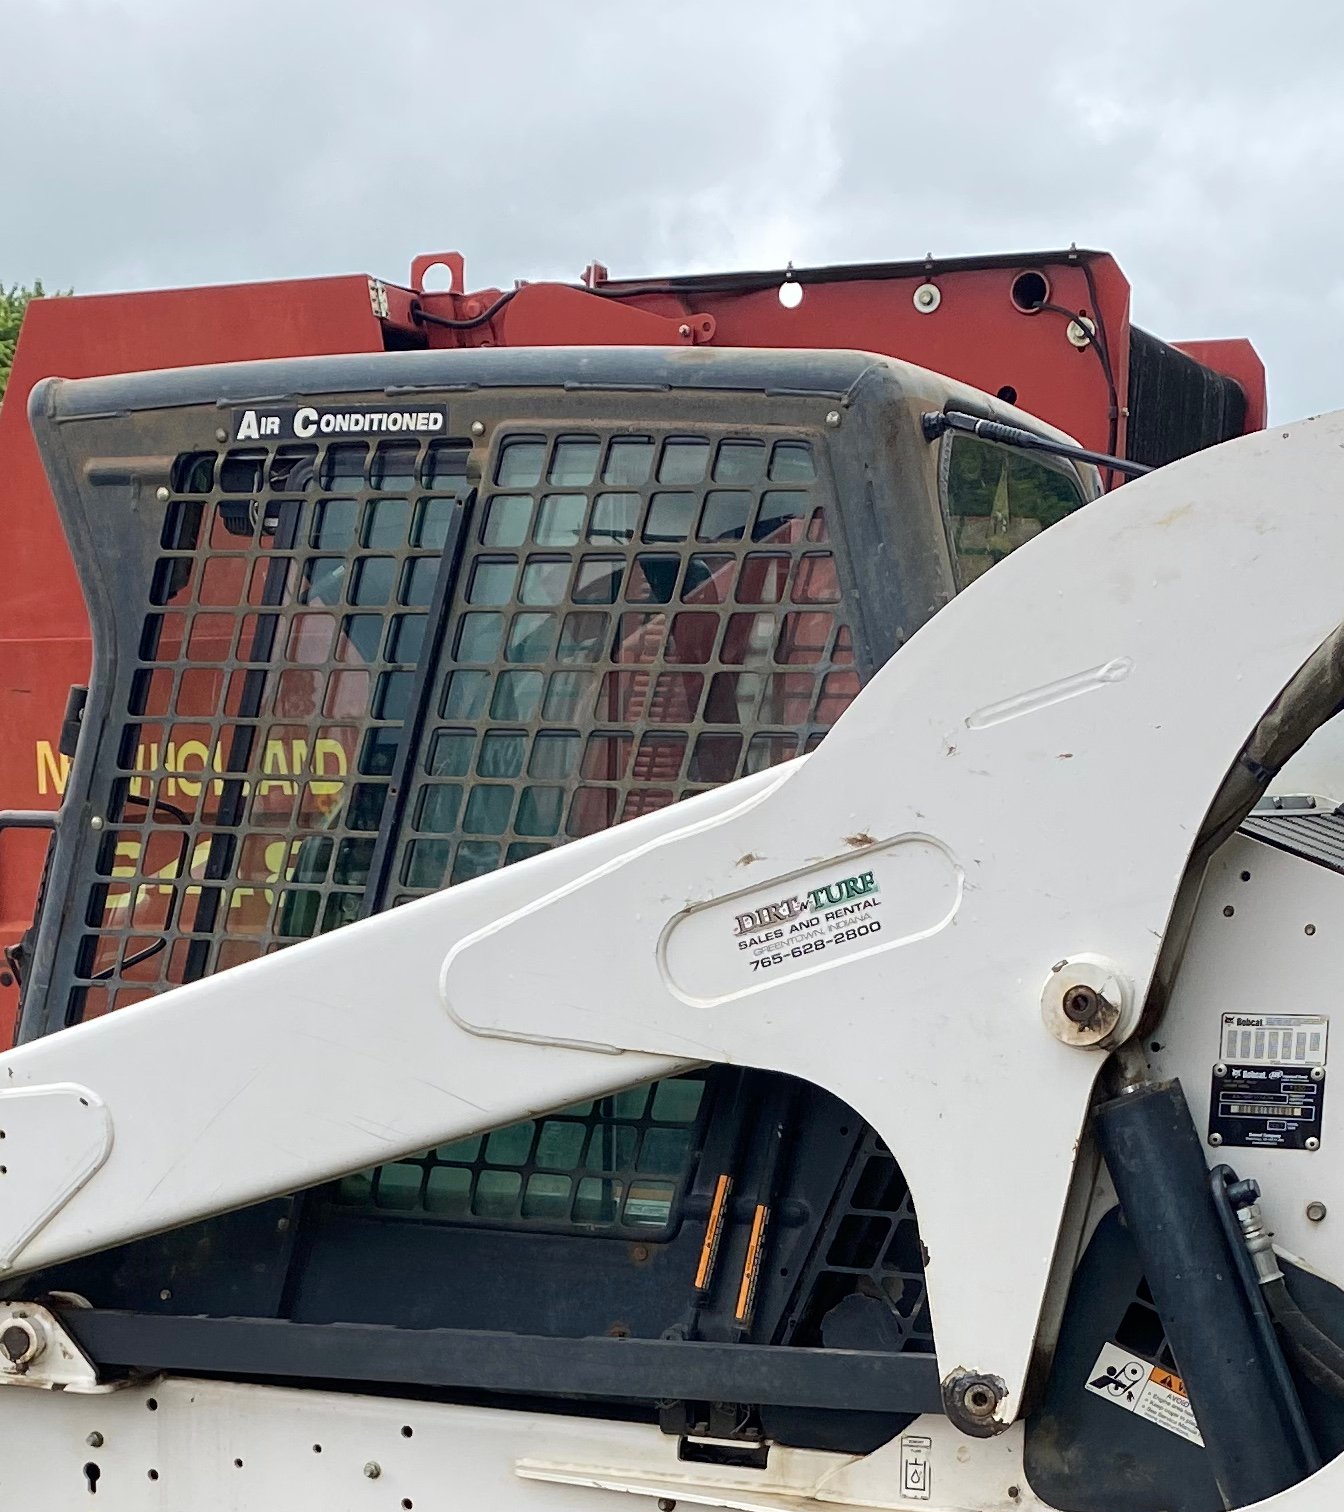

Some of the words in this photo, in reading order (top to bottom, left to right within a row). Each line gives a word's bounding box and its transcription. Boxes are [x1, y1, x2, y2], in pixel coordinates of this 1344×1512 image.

[237, 410, 280, 440] AIR
[293, 407, 443, 437] CONDITIONED
[734, 896, 798, 935] DIRT
[808, 871, 877, 910] TURF
[738, 929, 783, 950] SALES
[789, 917, 820, 933] AND
[825, 897, 881, 921] RENTAL
[828, 912, 872, 932] INDIANA
[749, 920, 881, 972] 765-628-2800
